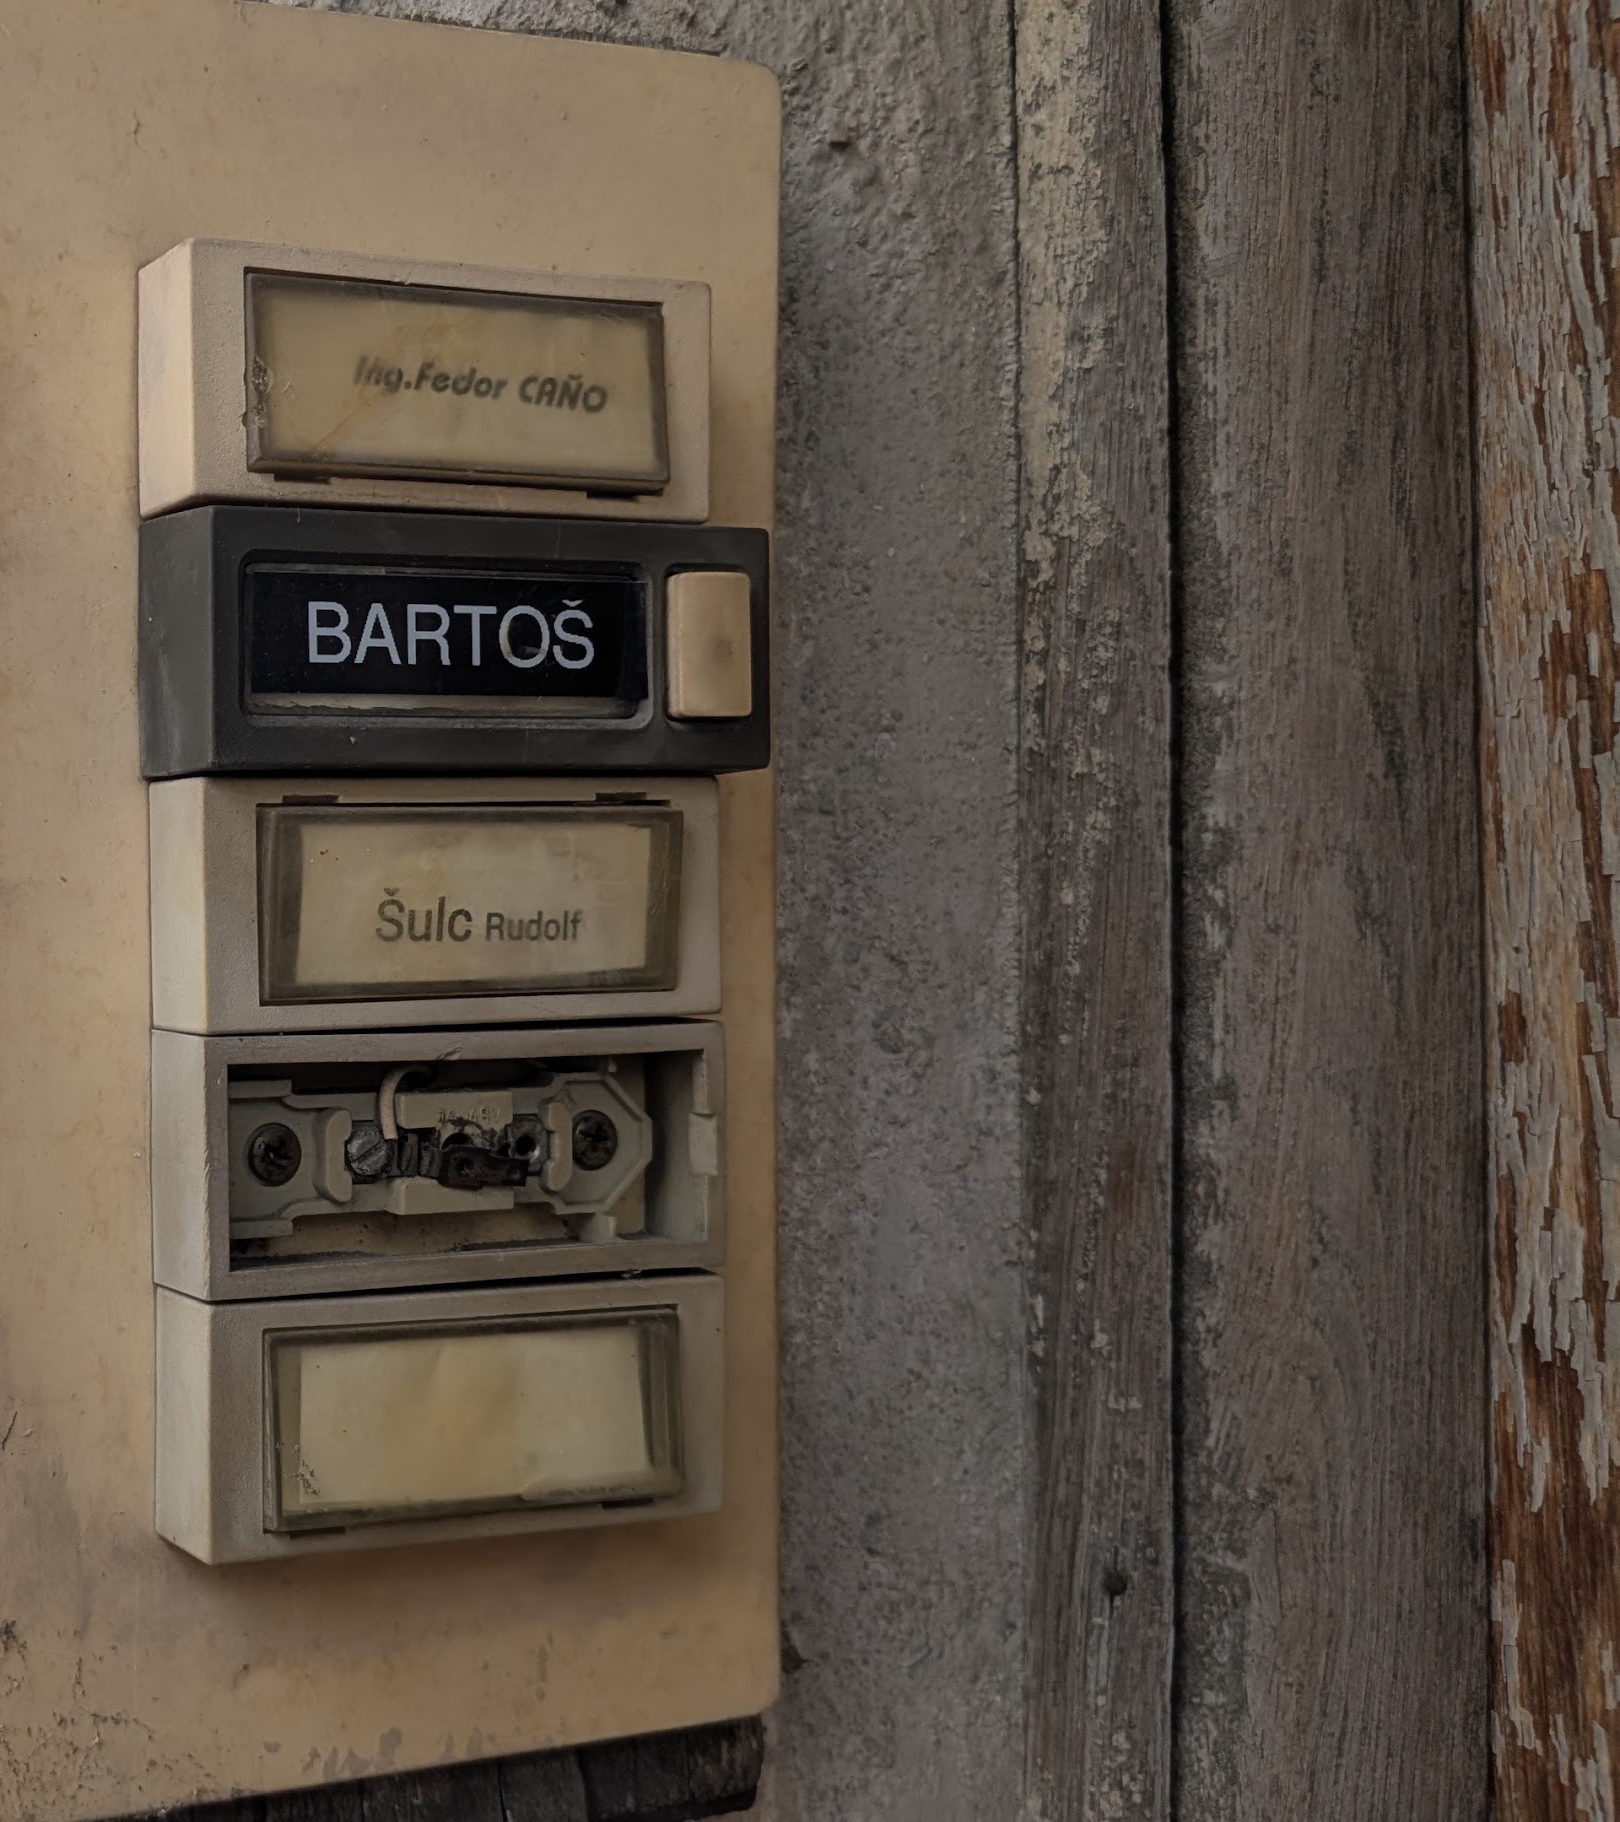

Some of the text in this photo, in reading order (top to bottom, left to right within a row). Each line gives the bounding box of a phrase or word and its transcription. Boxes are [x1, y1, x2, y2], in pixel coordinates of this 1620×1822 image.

[307, 599, 595, 670] BARTOŠ
[375, 887, 584, 943] Šulc Rudolf
